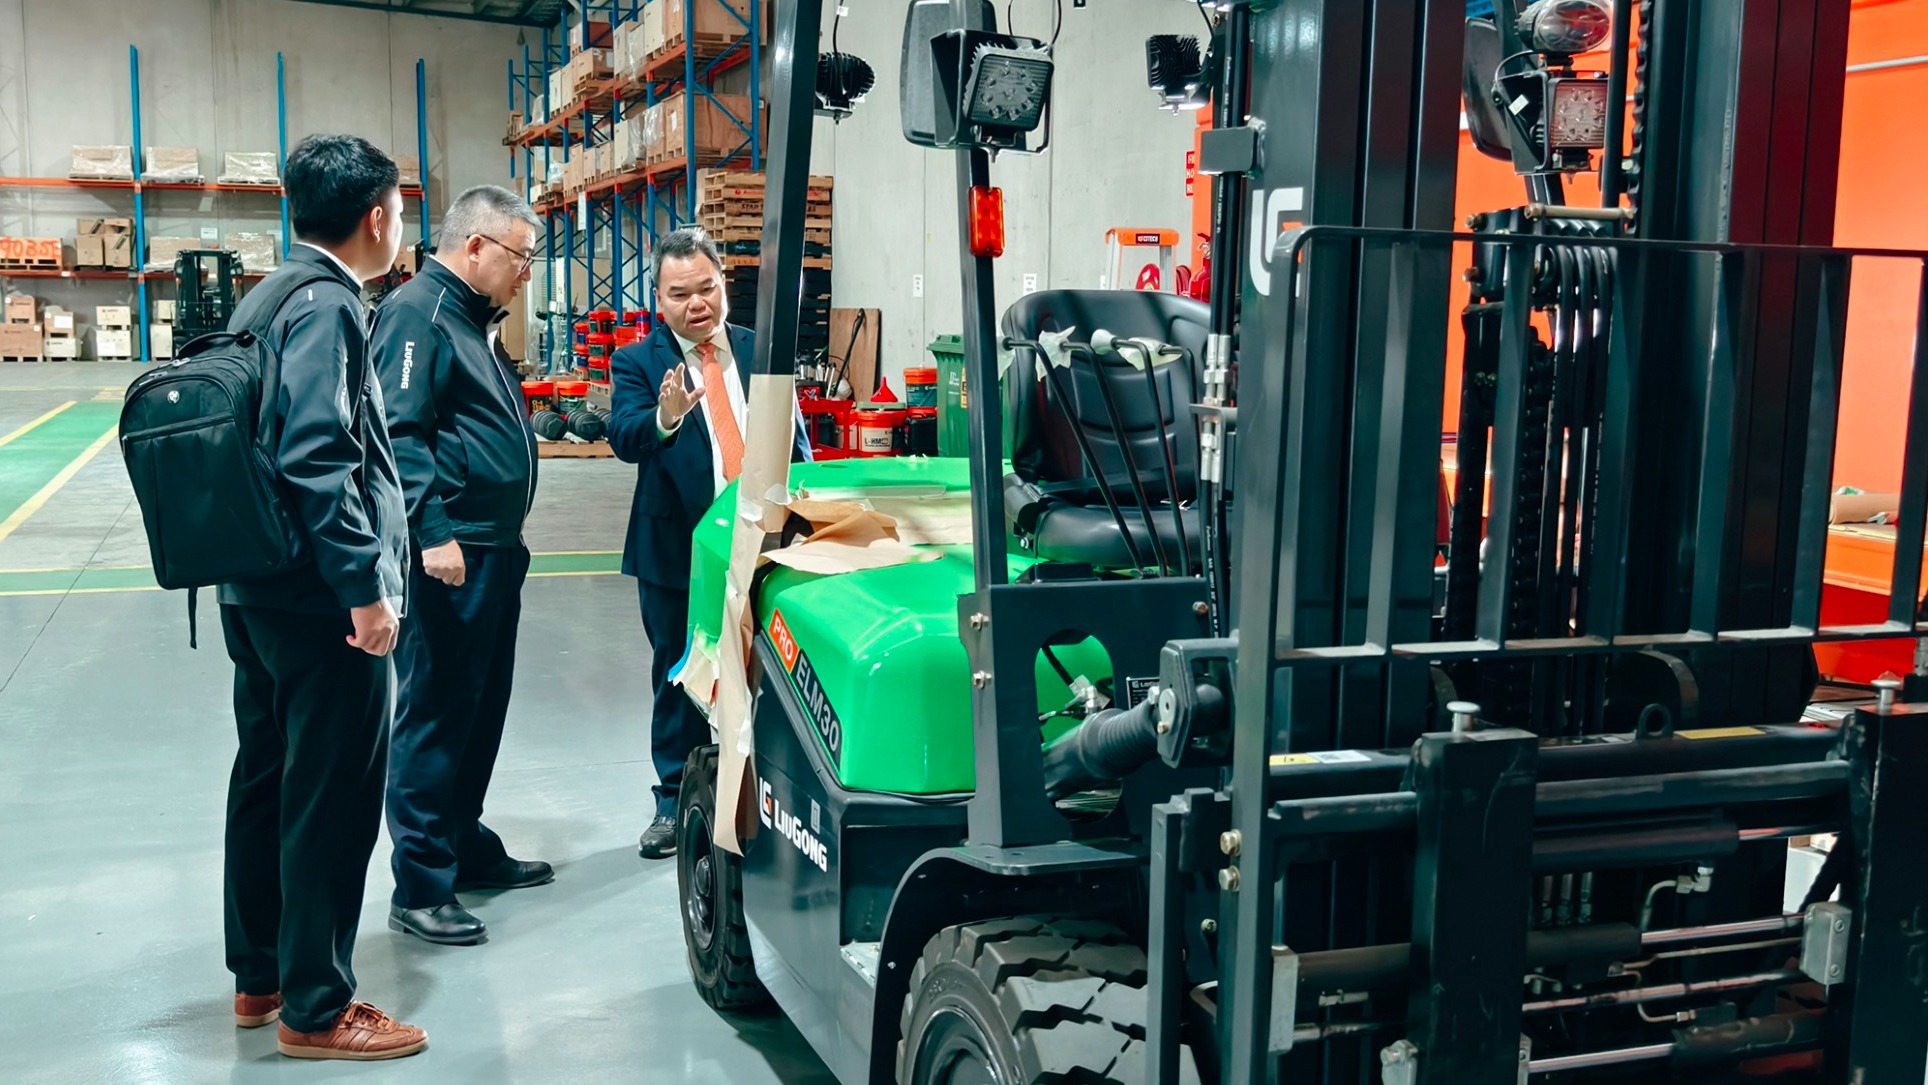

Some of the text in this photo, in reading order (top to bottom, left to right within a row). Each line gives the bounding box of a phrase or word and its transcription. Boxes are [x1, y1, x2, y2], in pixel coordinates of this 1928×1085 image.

[773, 615, 793, 661] PRO
[796, 652, 840, 752] ELM30
[775, 798, 827, 872] LIUGONG
